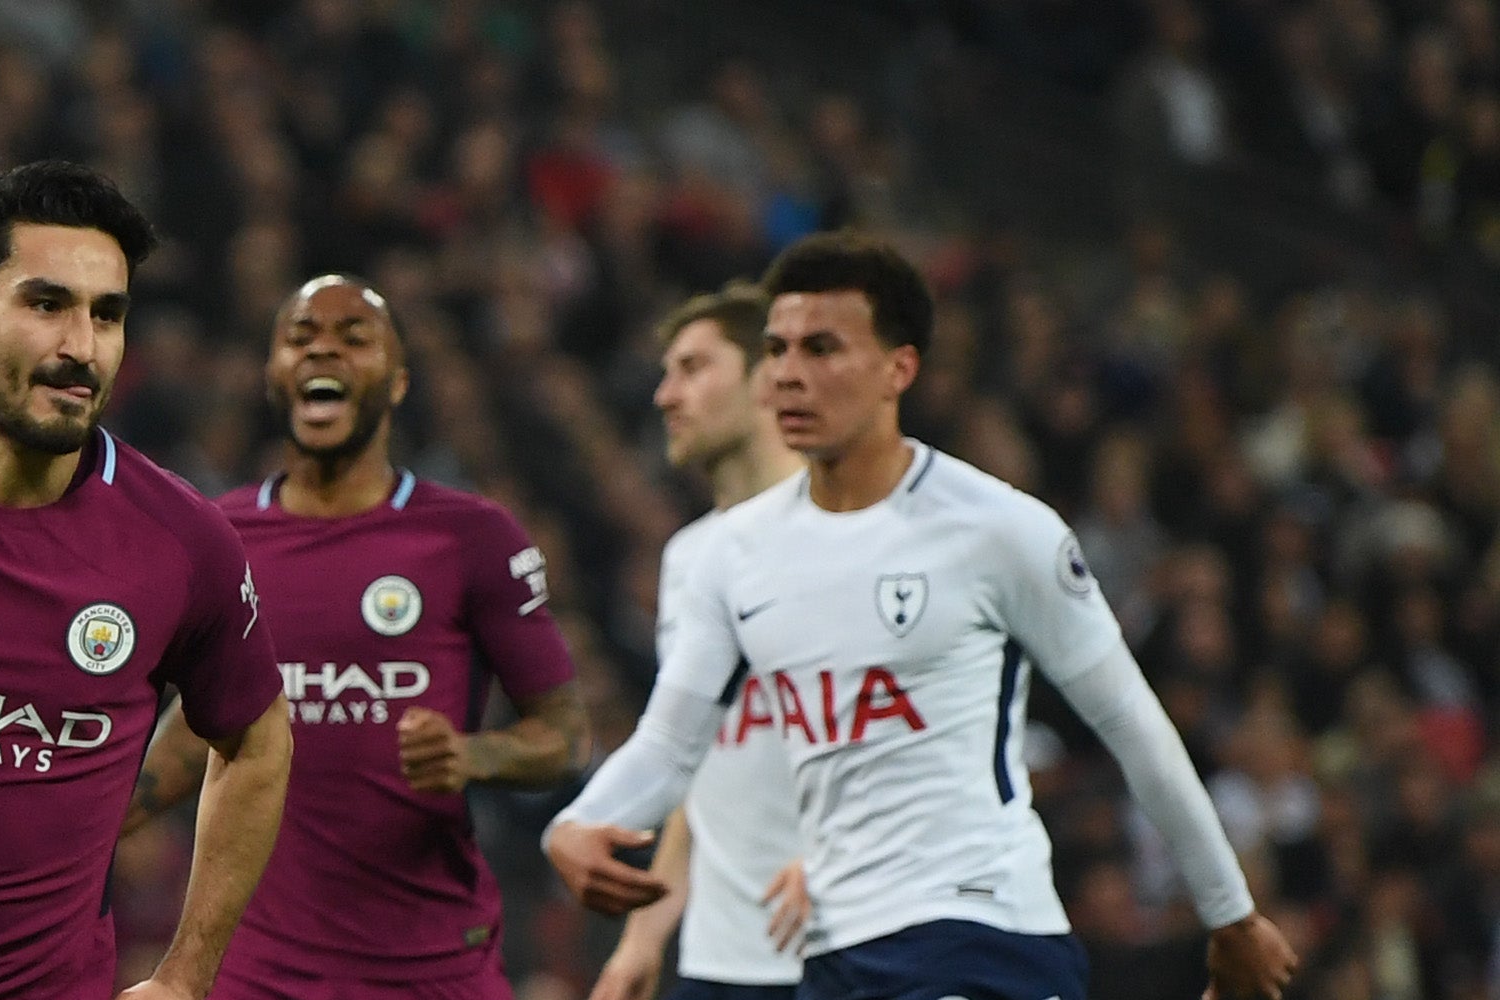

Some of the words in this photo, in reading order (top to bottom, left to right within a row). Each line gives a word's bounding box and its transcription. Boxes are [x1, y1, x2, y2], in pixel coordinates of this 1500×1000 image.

[77, 607, 131, 634] MANCHESTER
[85, 660, 106, 671] CITY
[276, 661, 431, 701] IHAD
[288, 700, 389, 725] WAYS
